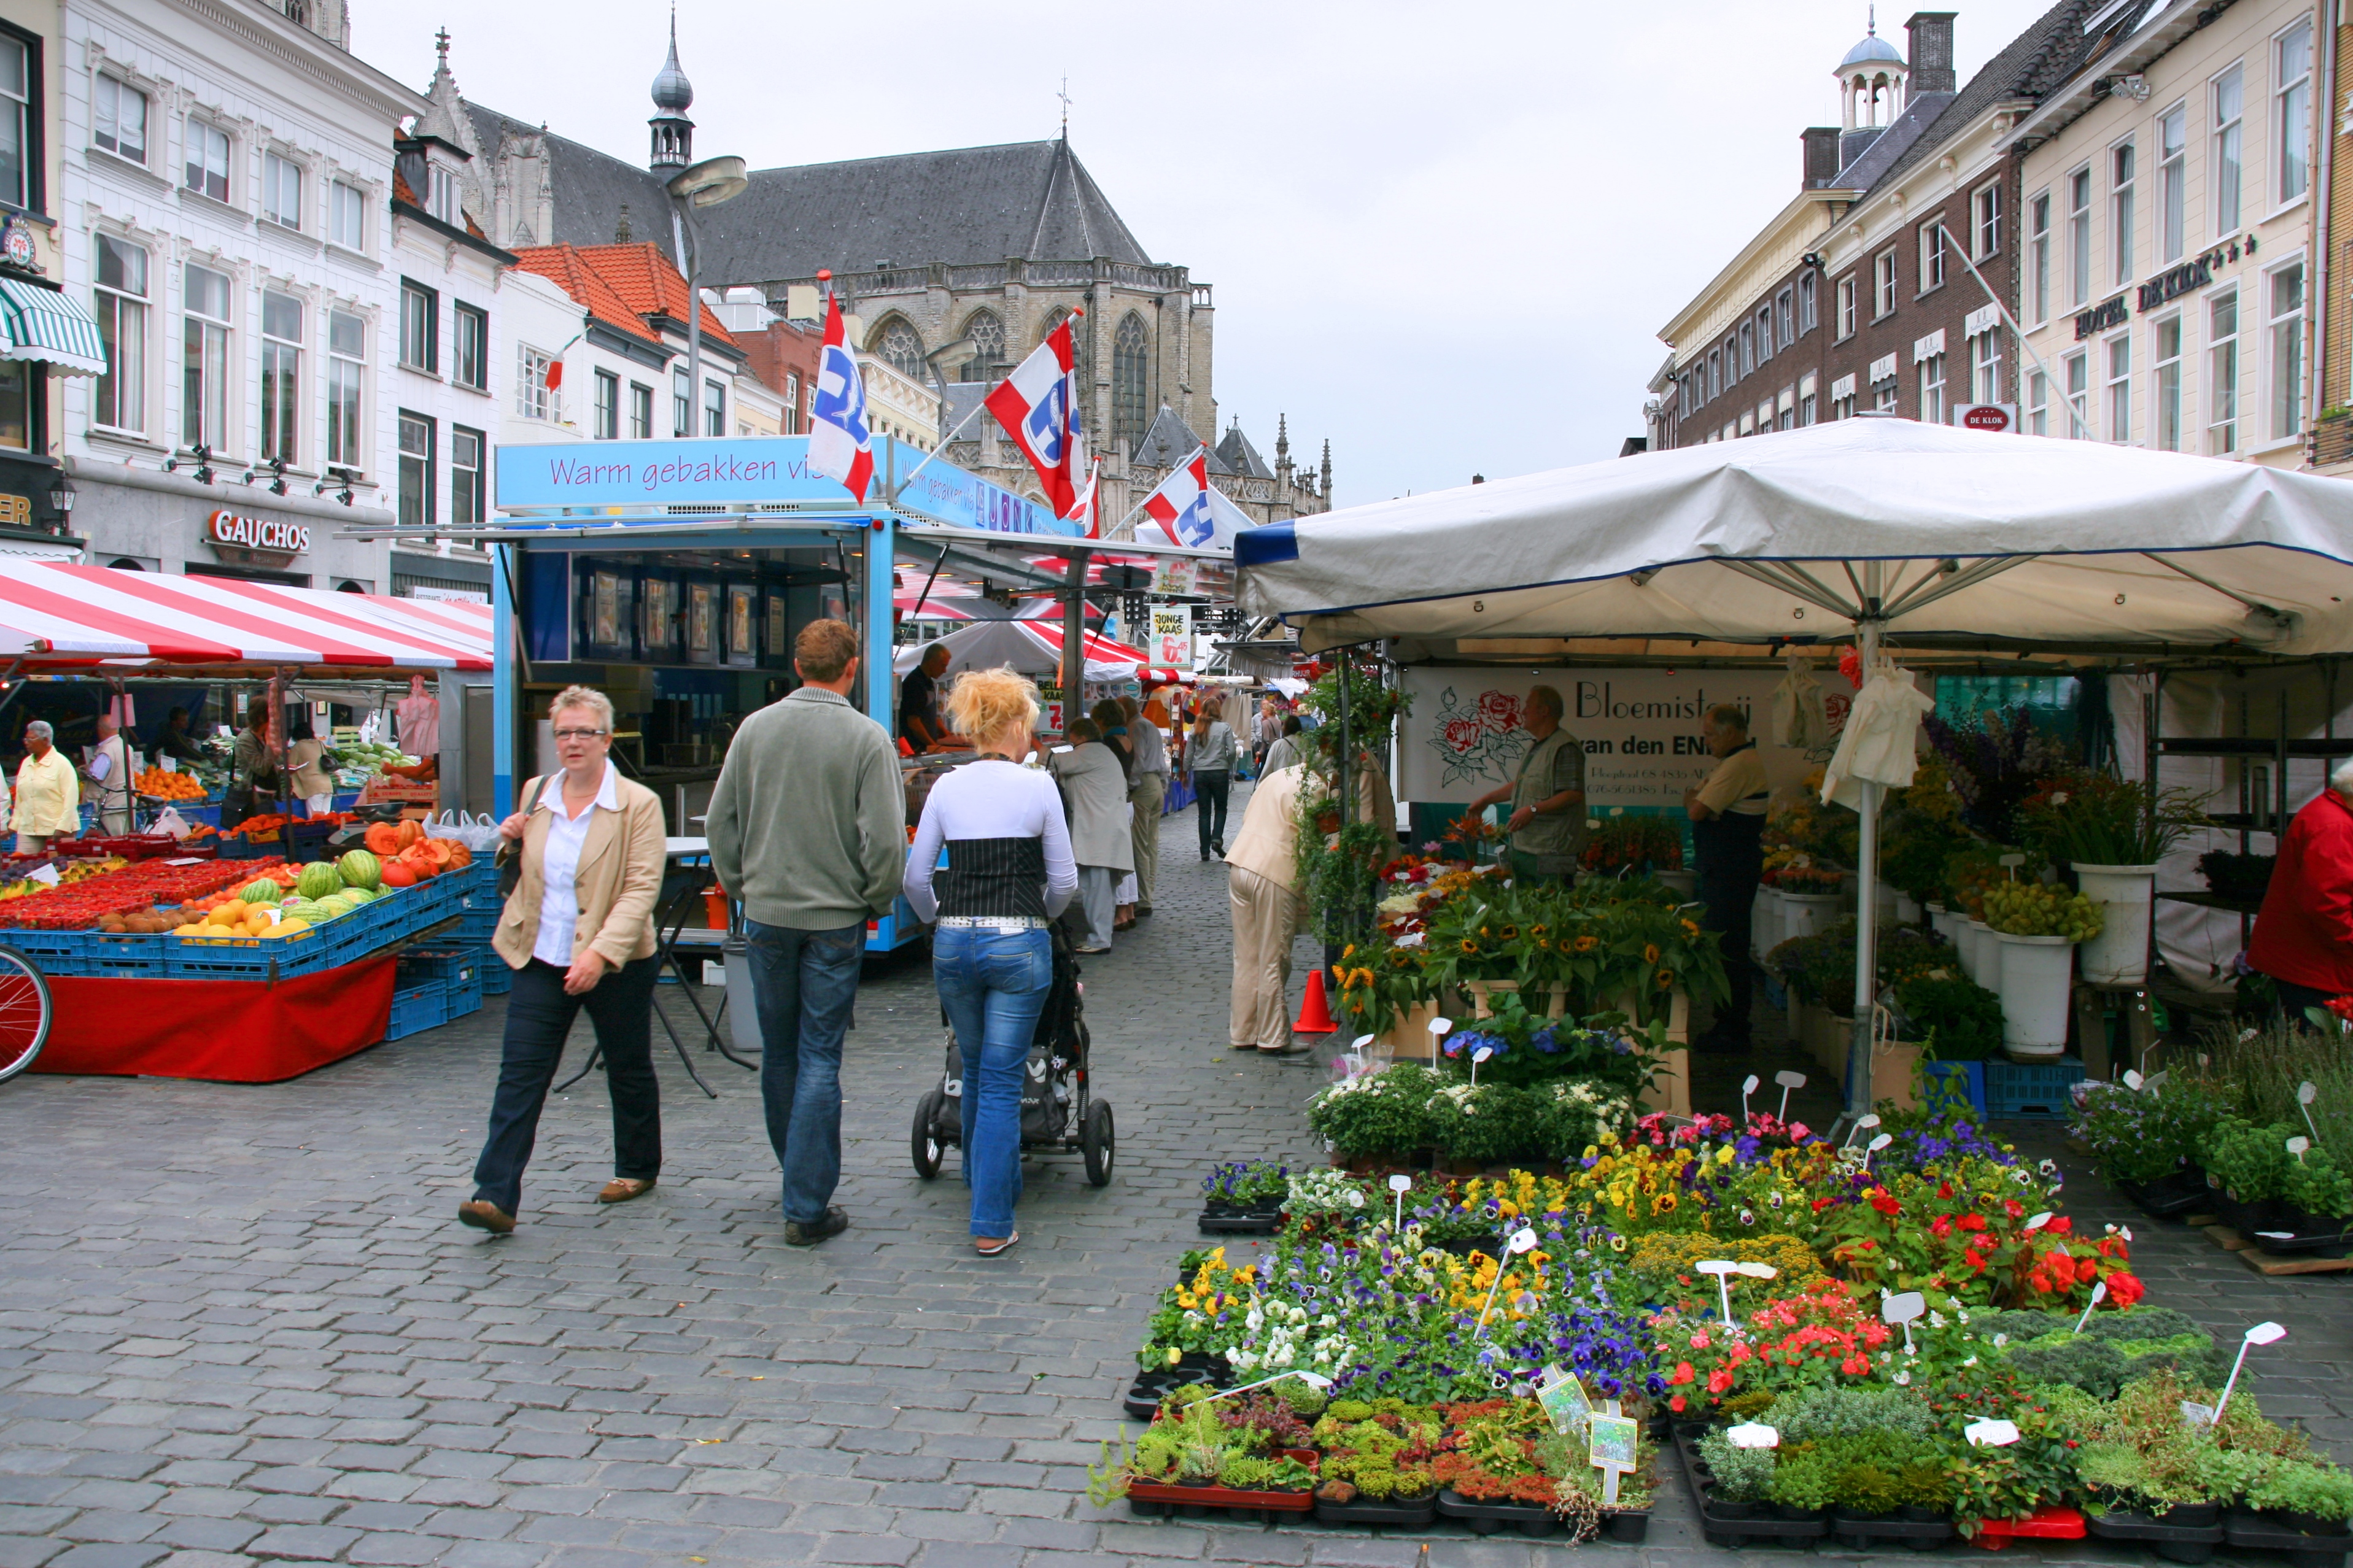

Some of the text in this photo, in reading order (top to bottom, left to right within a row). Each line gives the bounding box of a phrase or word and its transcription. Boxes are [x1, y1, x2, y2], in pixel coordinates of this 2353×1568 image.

[2074, 253, 2212, 341] HOTEL DE KLOK
[551, 458, 631, 485] Warm
[642, 454, 776, 491] gebakken
[928, 476, 962, 508] gebakken
[964, 492, 974, 510] vis
[215, 510, 310, 551] GAUCHOS
[1155, 614, 1184, 624] JONGE
[1158, 624, 1183, 634] KAAS
[1621, 735, 1664, 755] den
